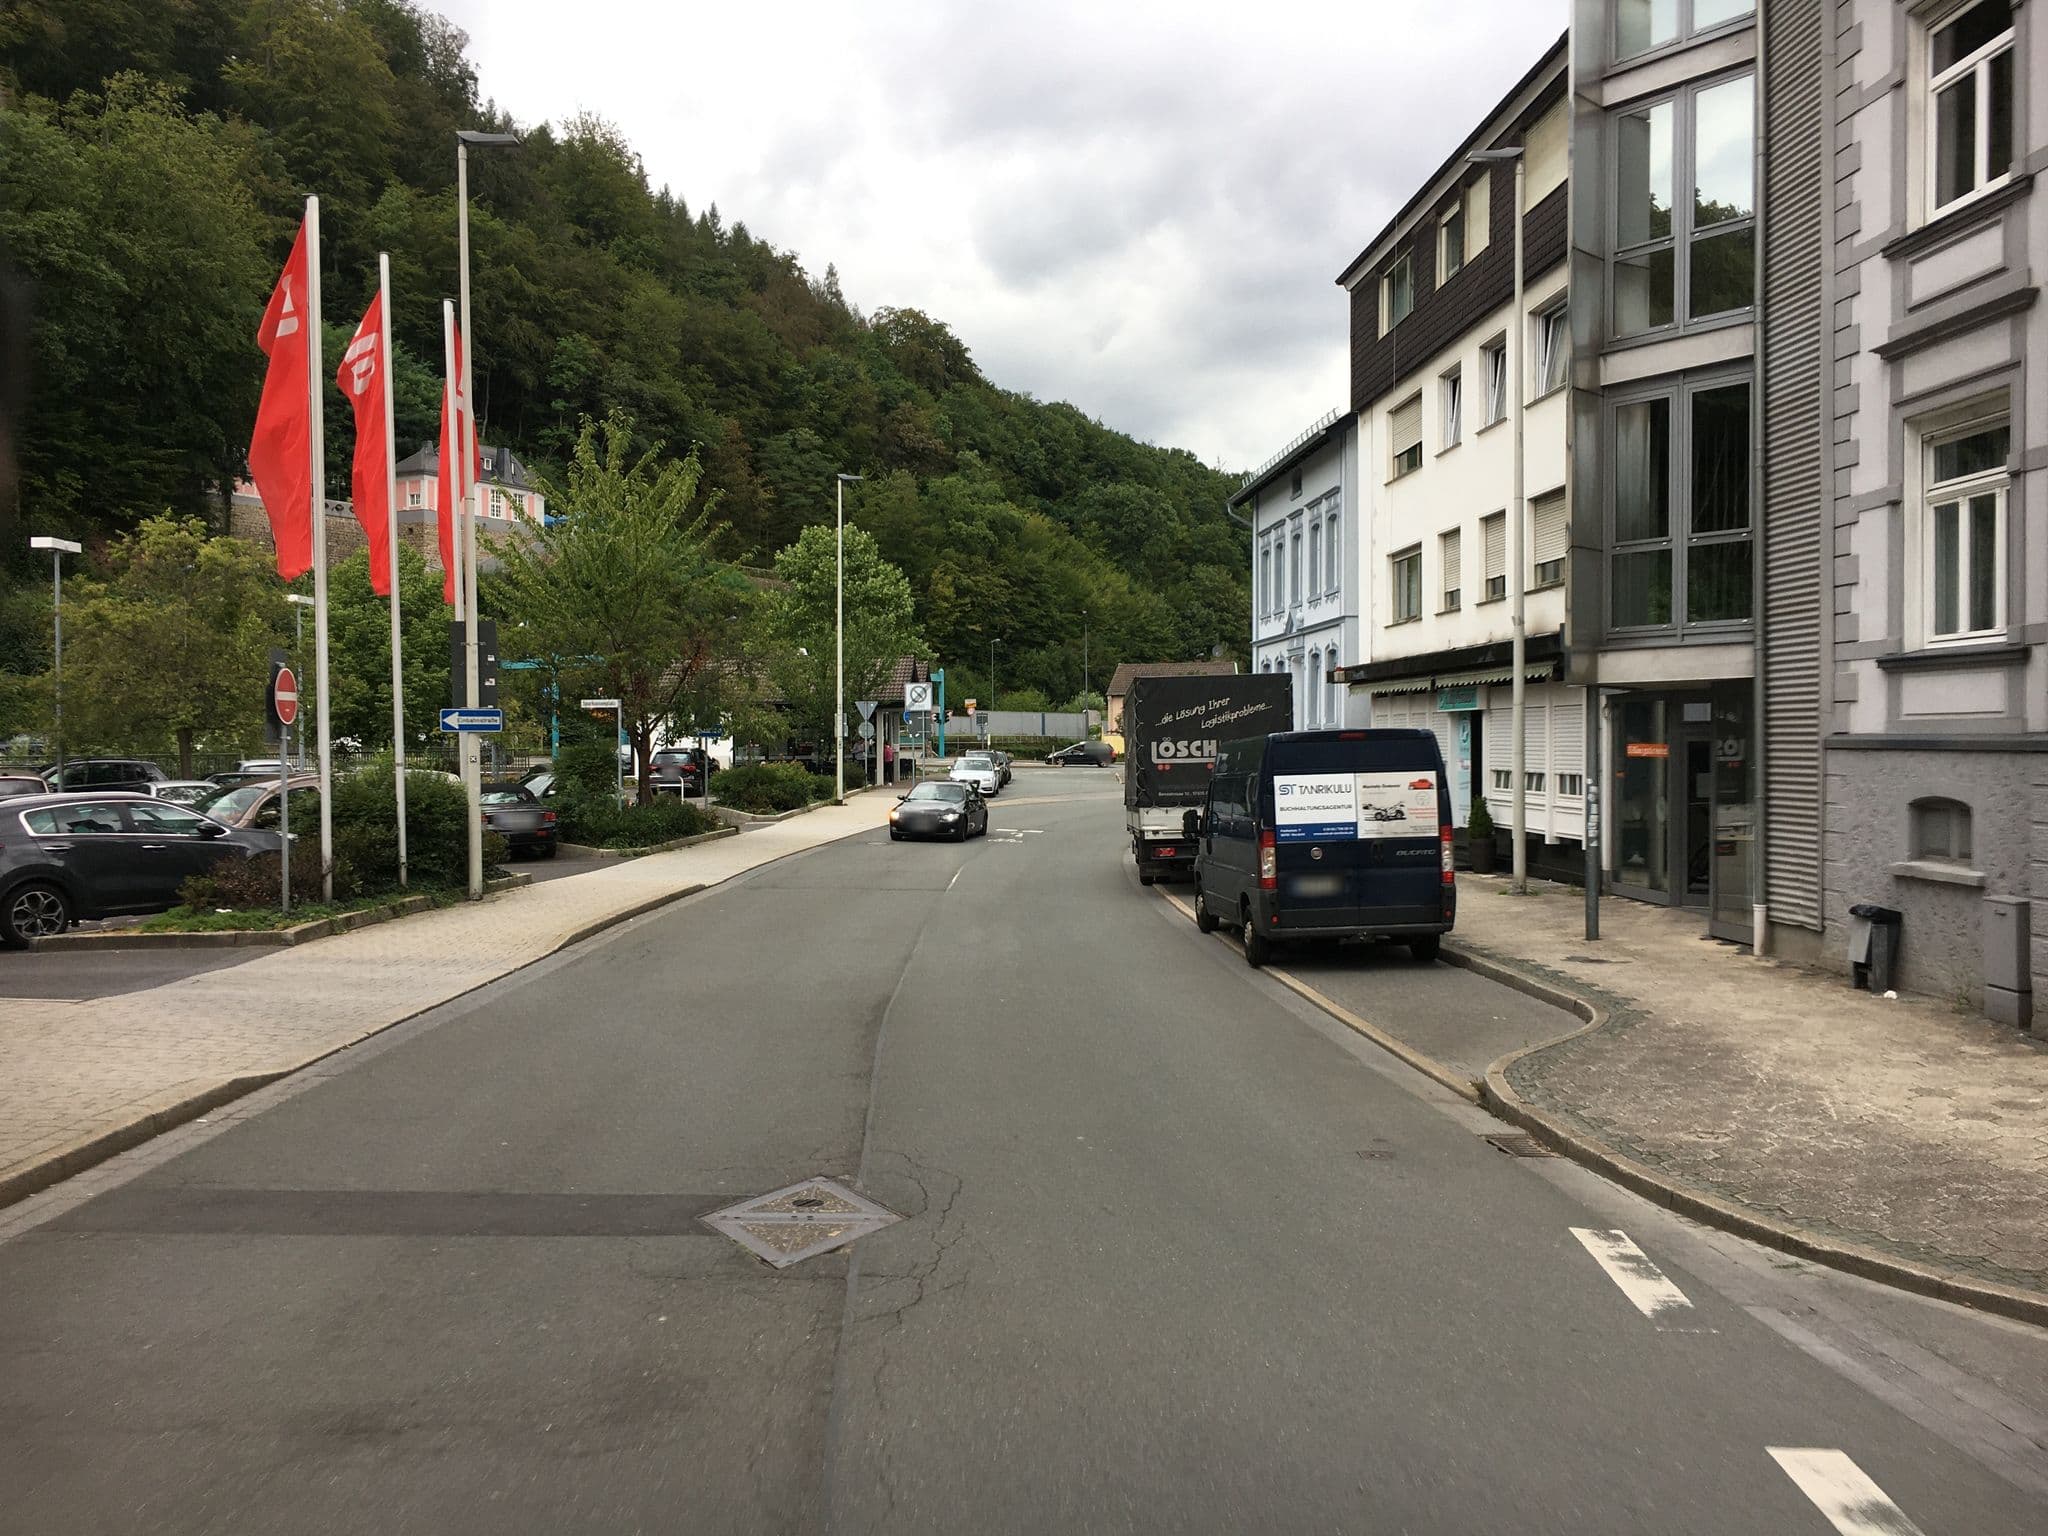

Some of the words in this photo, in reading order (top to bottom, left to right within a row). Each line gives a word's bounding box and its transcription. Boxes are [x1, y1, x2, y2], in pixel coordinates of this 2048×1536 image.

[1175, 704, 1205, 721] Lösung
[1208, 697, 1231, 710] Ihrer
[1299, 784, 1352, 795] TANRIKULU
[1279, 804, 1353, 812] BUCHHALTUNGSAGENTUR
